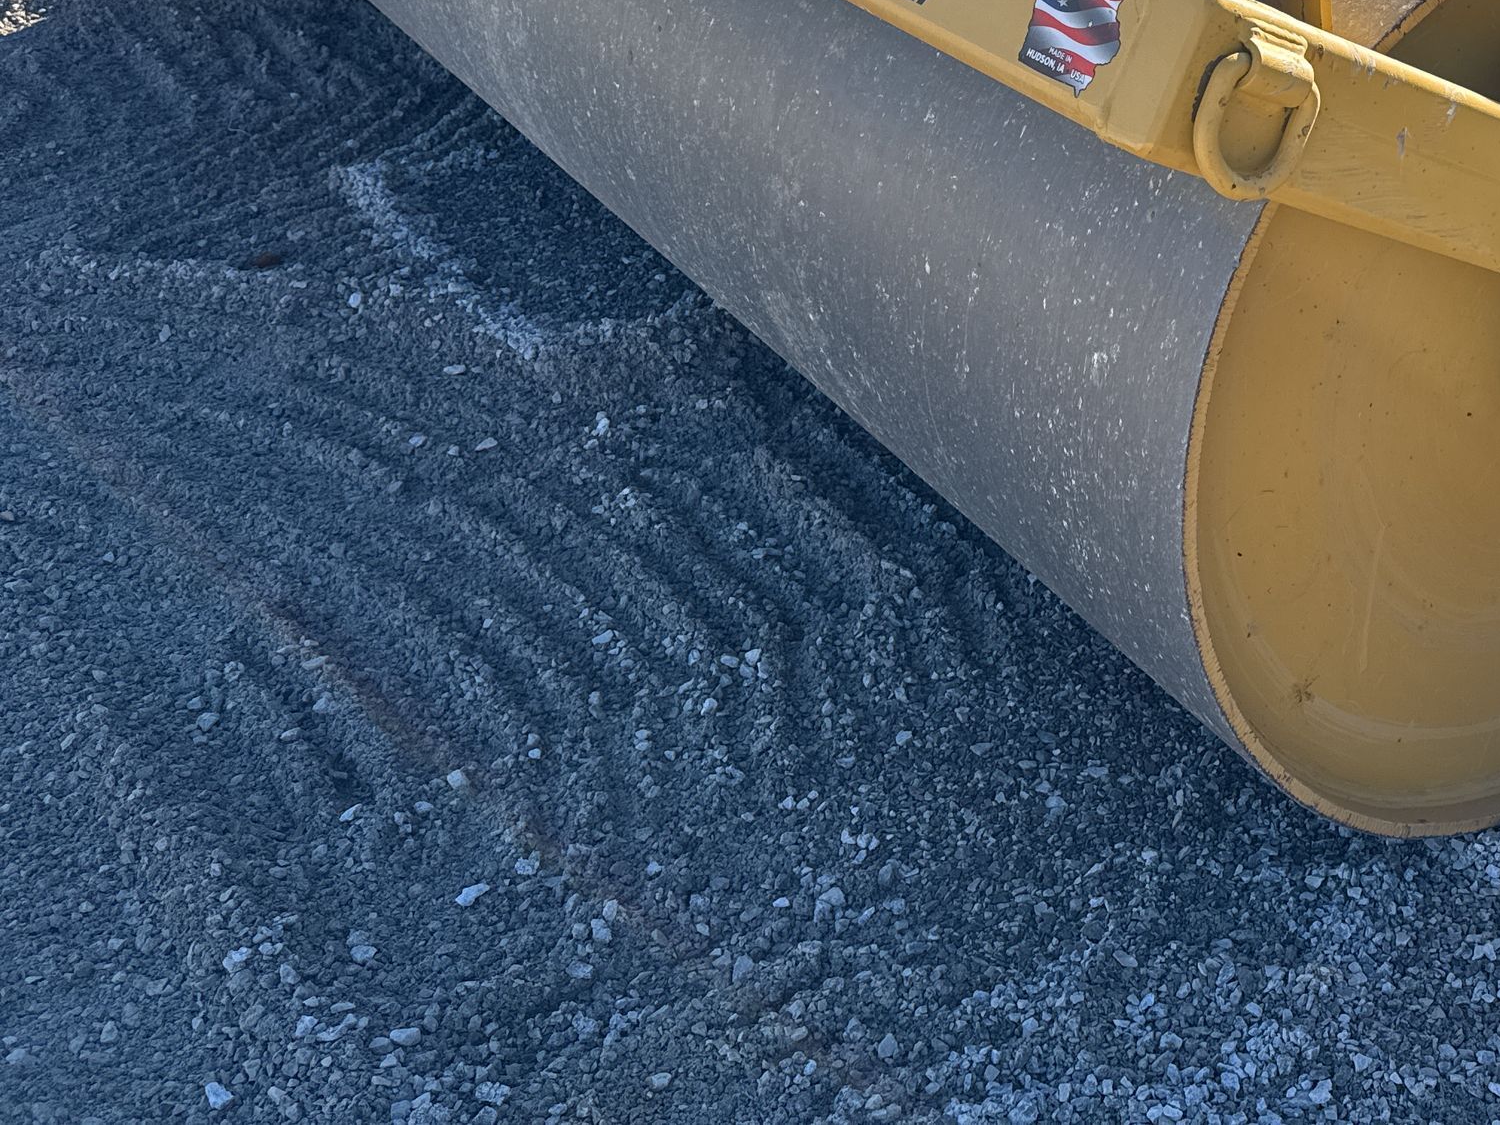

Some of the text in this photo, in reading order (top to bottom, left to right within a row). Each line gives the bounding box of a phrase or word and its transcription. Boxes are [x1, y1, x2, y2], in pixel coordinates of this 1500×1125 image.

[1026, 48, 1085, 84] HUDSON, IA USA
[1048, 47, 1073, 63] MADE IN
